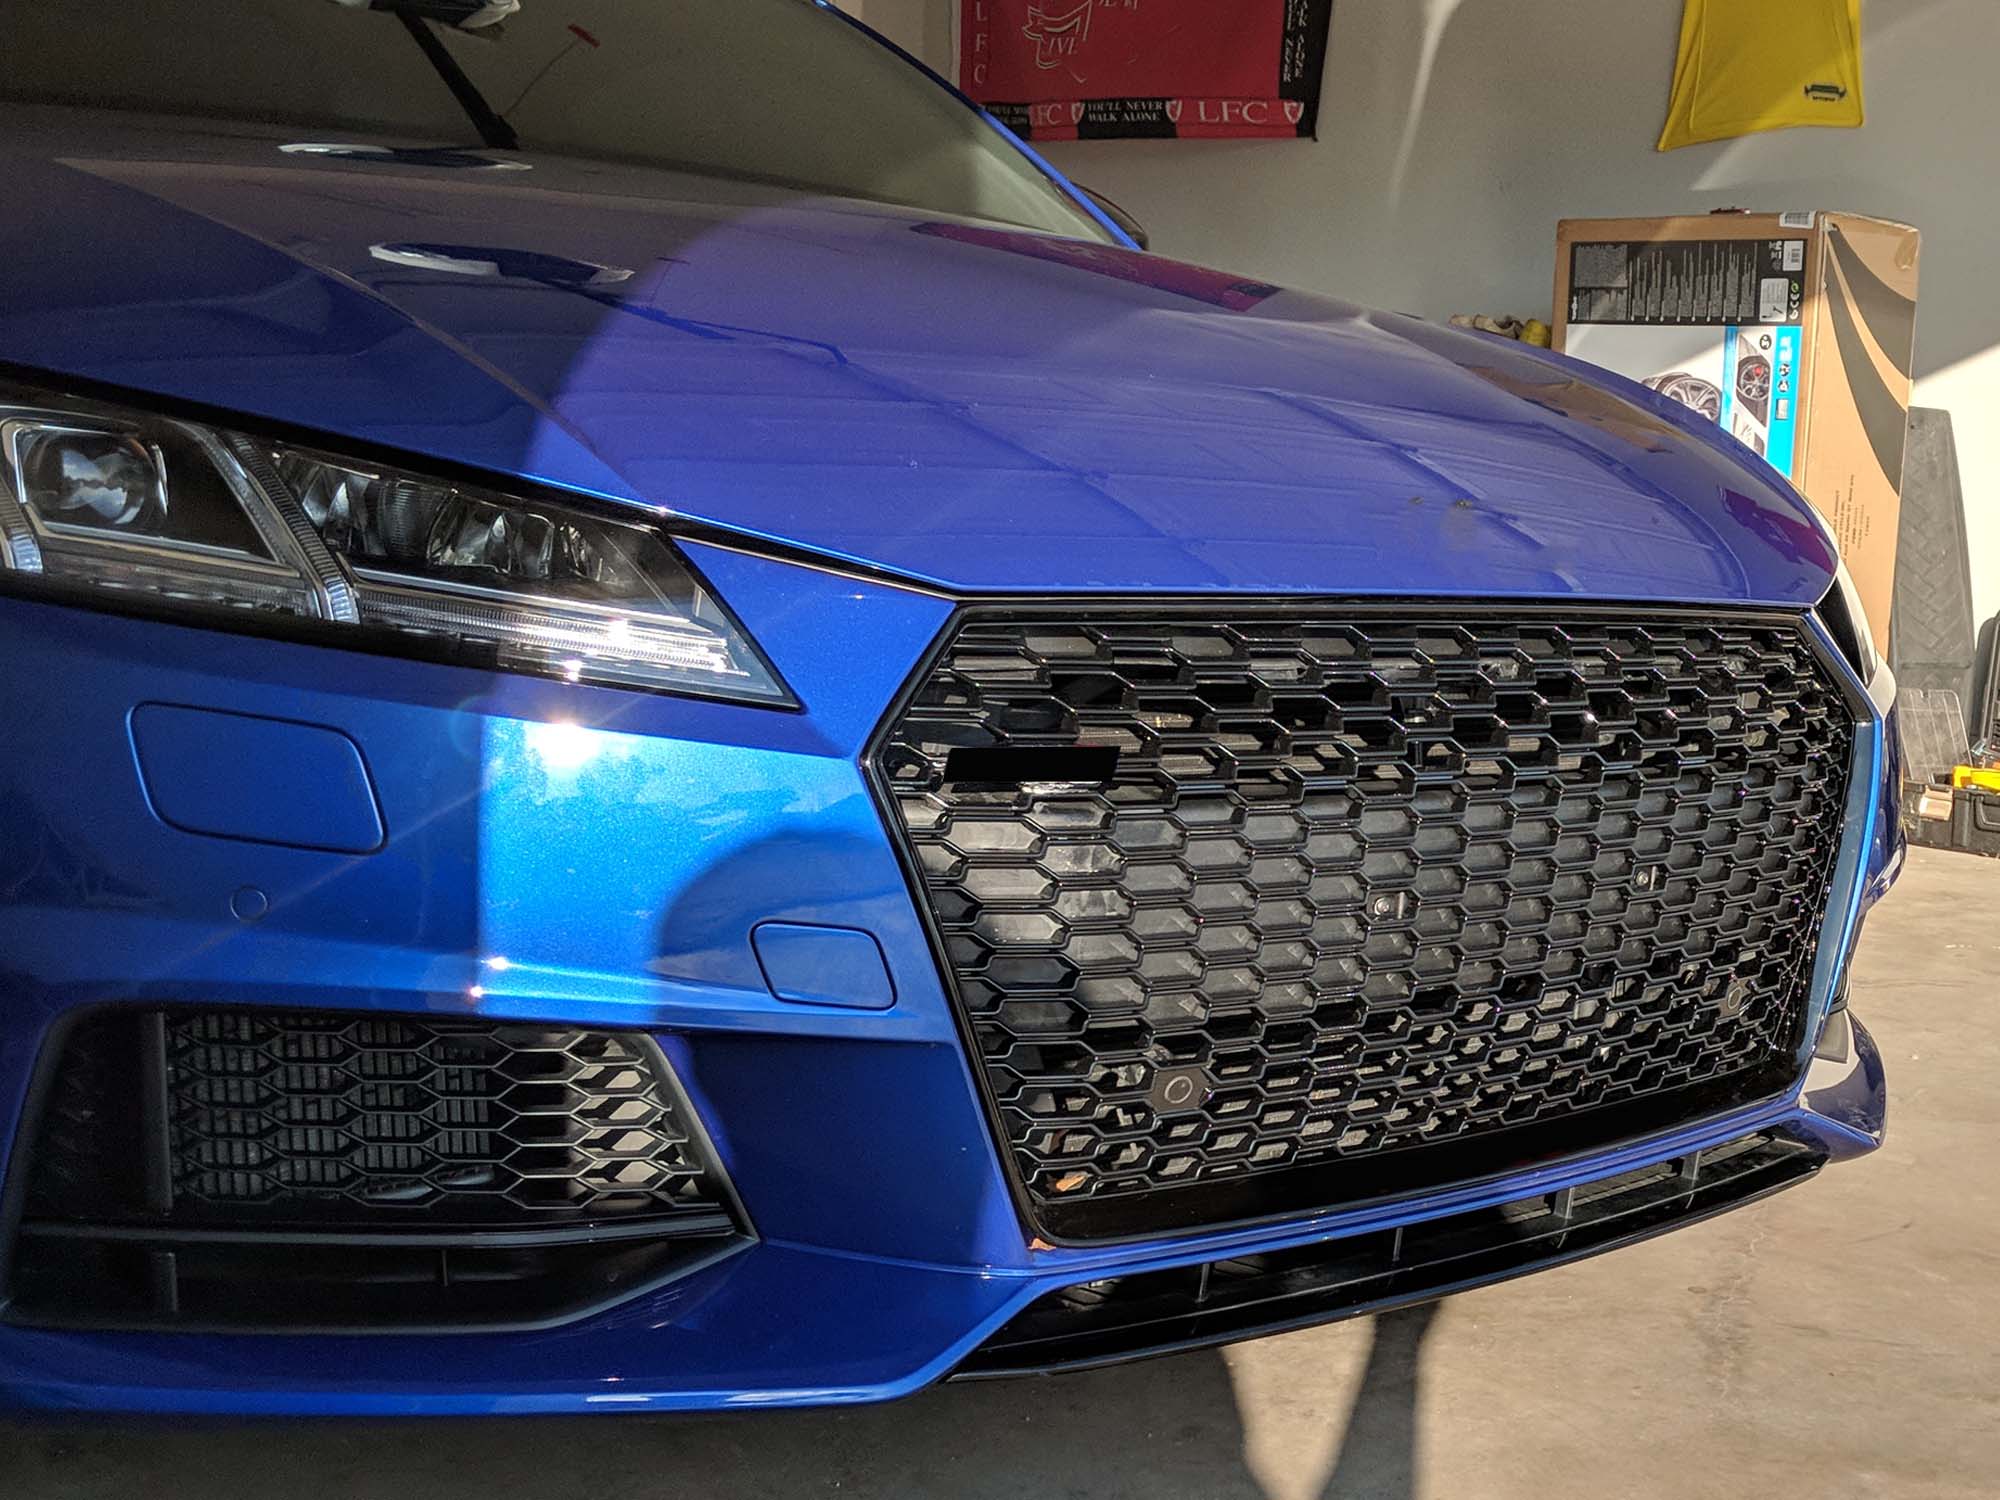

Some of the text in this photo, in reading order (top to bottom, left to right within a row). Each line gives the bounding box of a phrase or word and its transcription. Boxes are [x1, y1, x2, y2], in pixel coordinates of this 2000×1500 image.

[1126, 101, 1164, 111] NEVER
[1088, 112, 1160, 122] WALK ALONE
[1198, 100, 1269, 125] LFC
